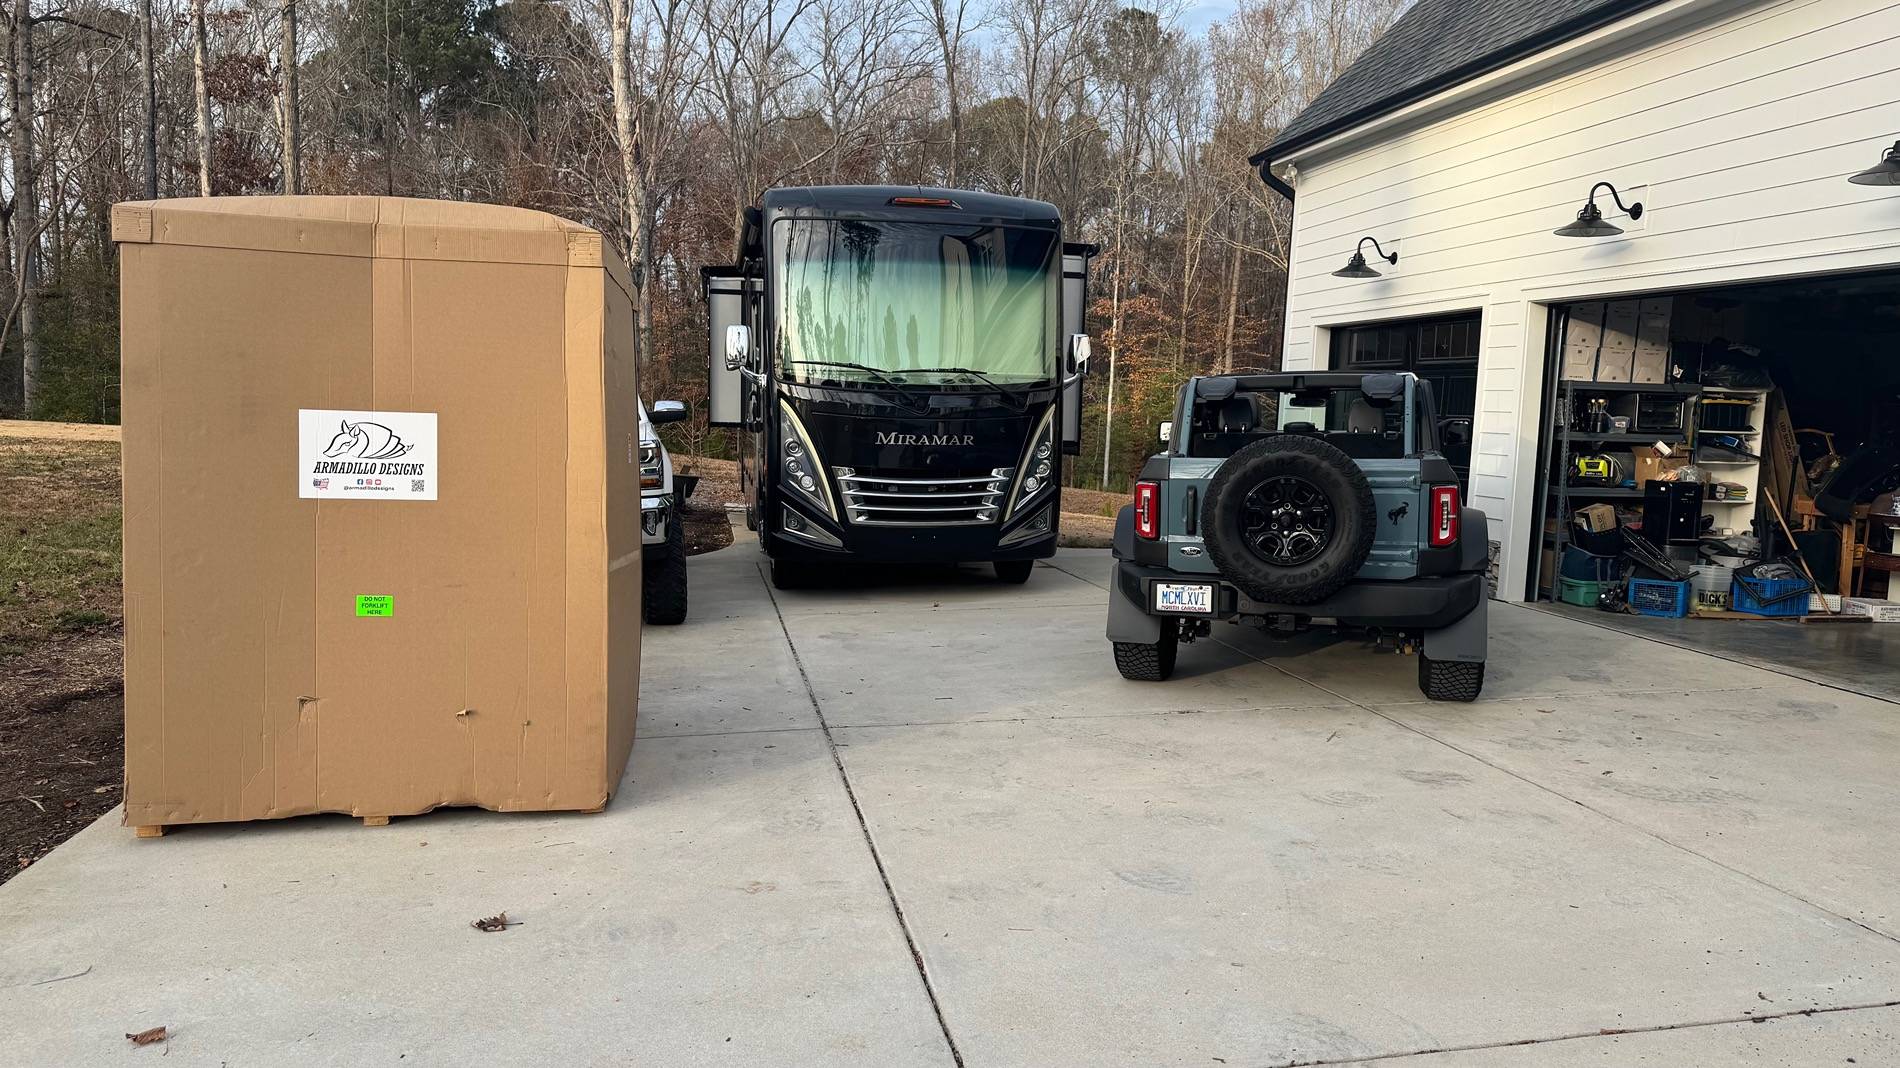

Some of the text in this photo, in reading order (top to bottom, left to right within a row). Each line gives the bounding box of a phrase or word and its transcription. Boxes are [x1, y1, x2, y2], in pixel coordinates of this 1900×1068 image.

[875, 432, 974, 446] MIRAMAR
[313, 461, 425, 476] ARMADILLO DESIGNS
[1161, 590, 1207, 606] MCMLXVI
